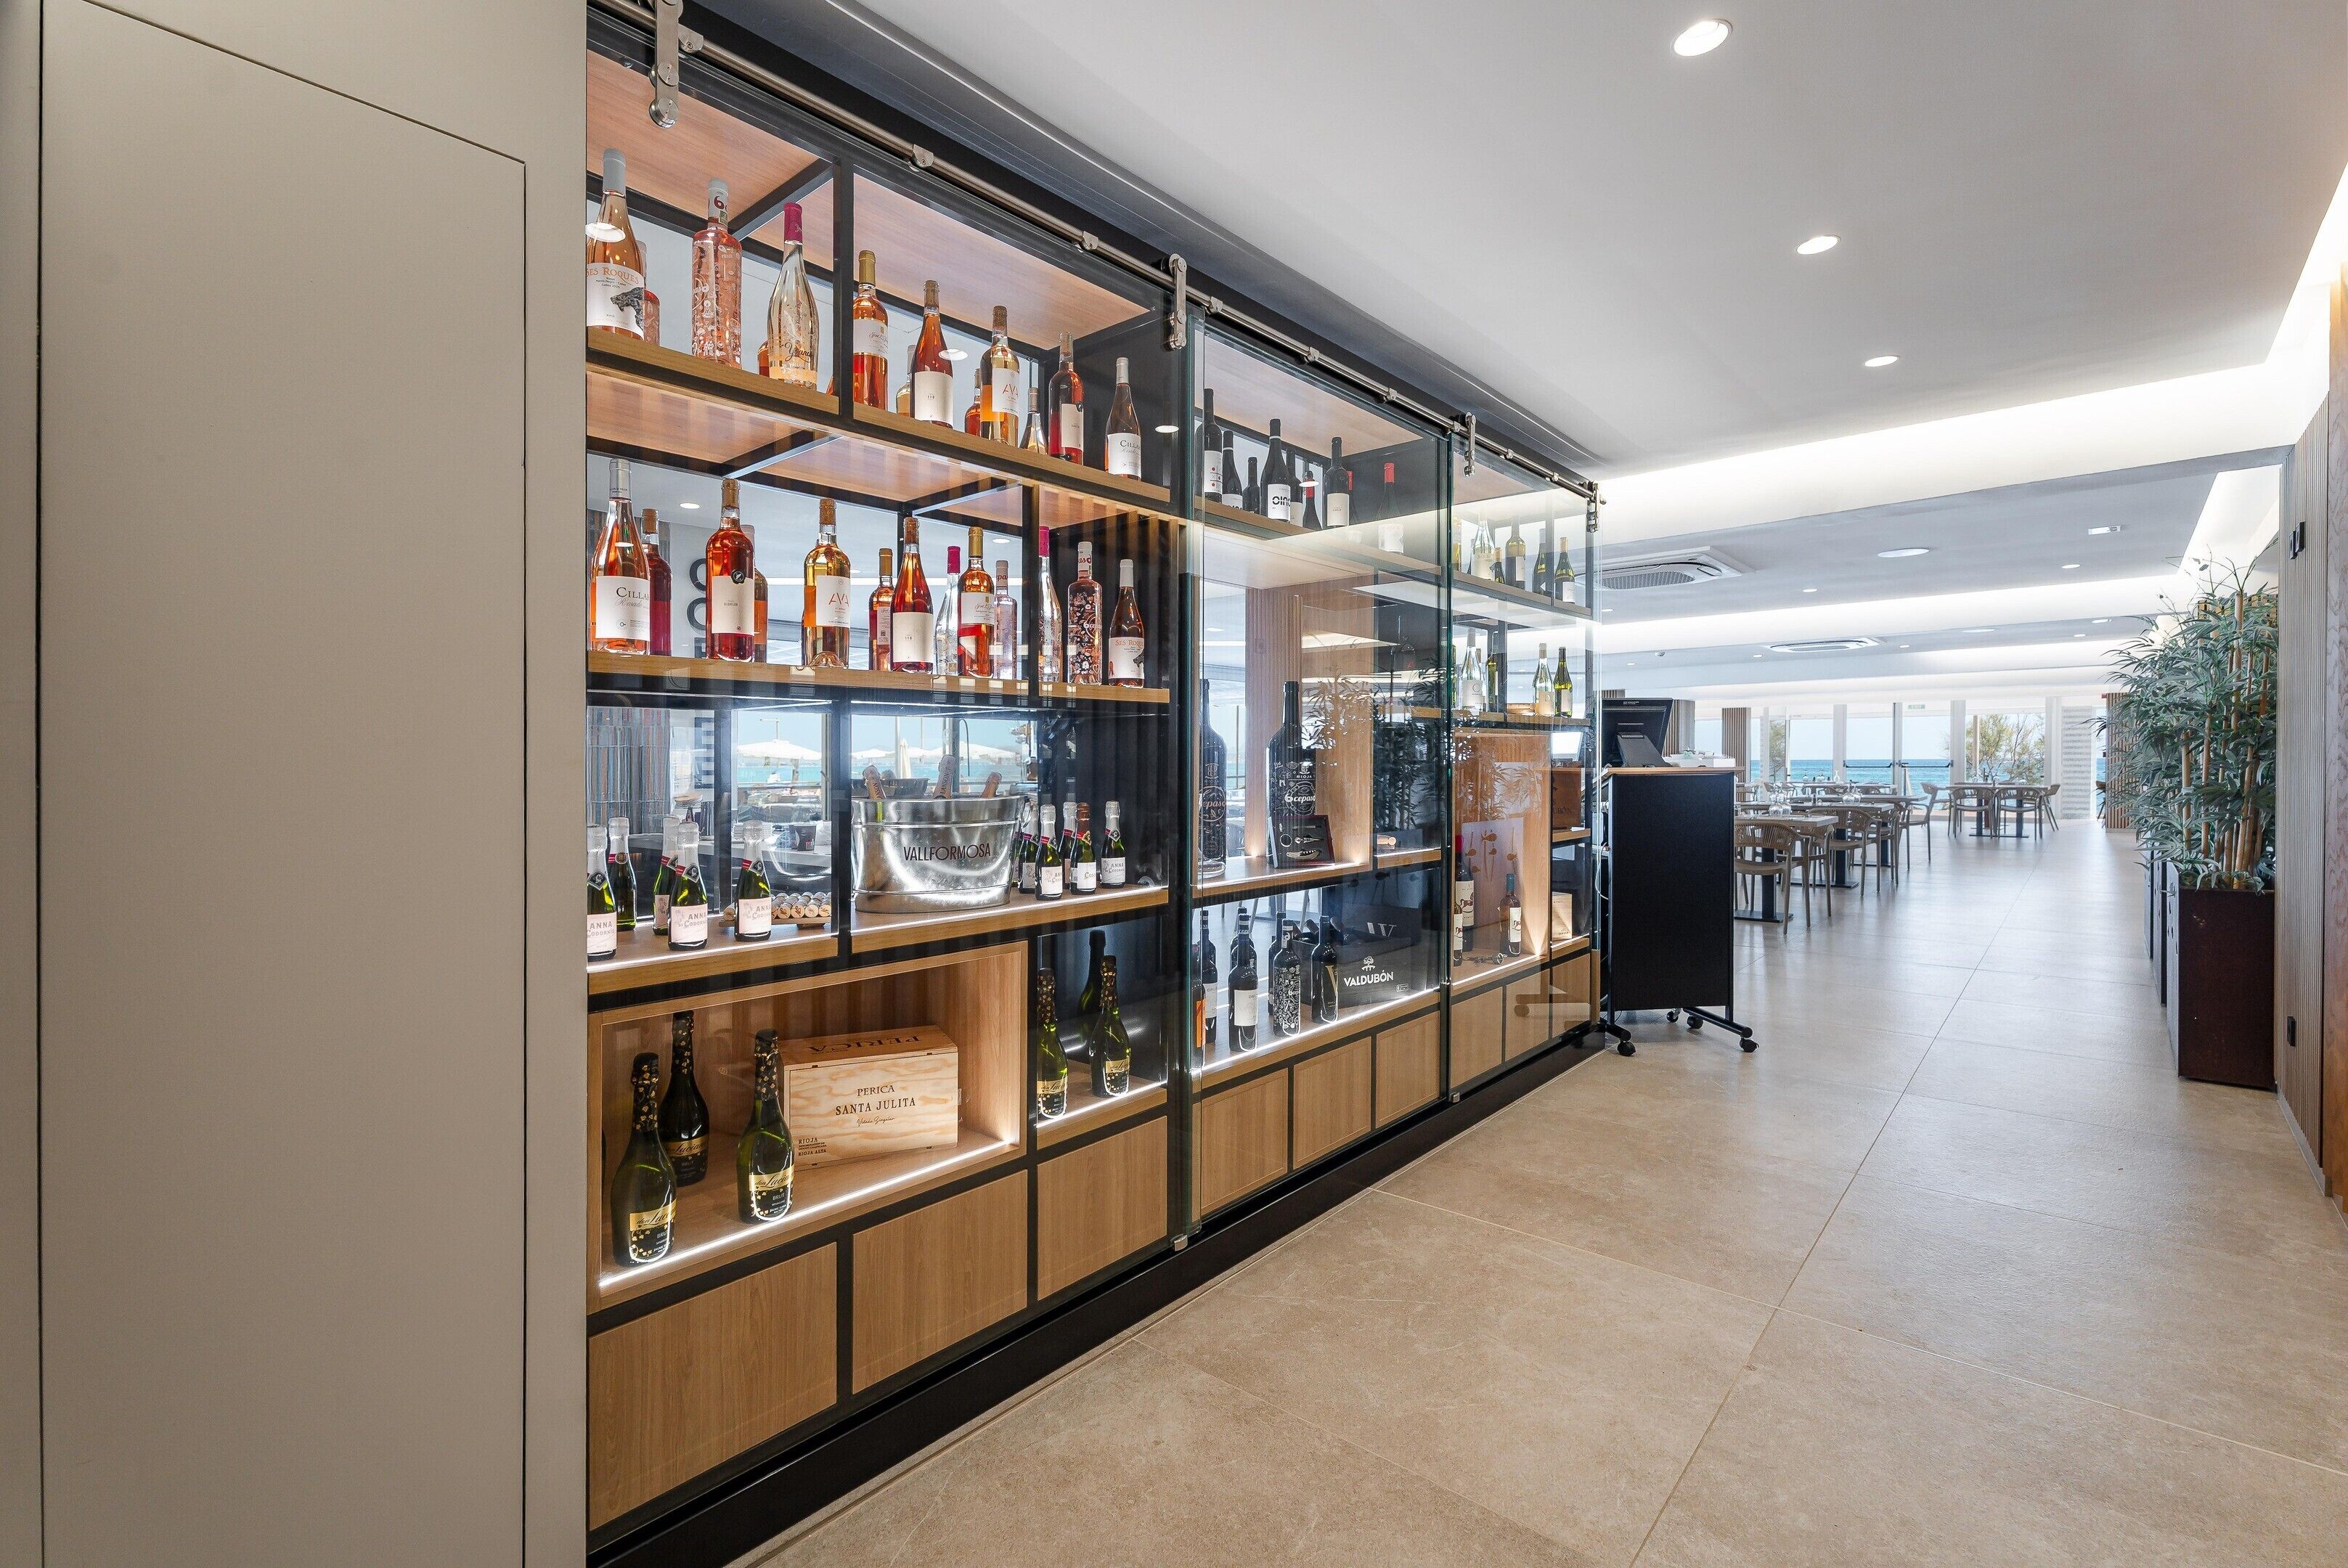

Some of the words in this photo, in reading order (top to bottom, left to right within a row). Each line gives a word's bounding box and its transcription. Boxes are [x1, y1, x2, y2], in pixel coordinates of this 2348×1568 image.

[602, 266, 639, 285] ROQUES
[903, 842, 992, 862] VALLFORMOSA
[590, 921, 613, 930] ANNA
[1343, 969, 1394, 987] VALDUBÓN
[857, 1085, 895, 1097] PERICA
[835, 1103, 872, 1116] SANTA
[876, 1097, 916, 1111] JULITA
